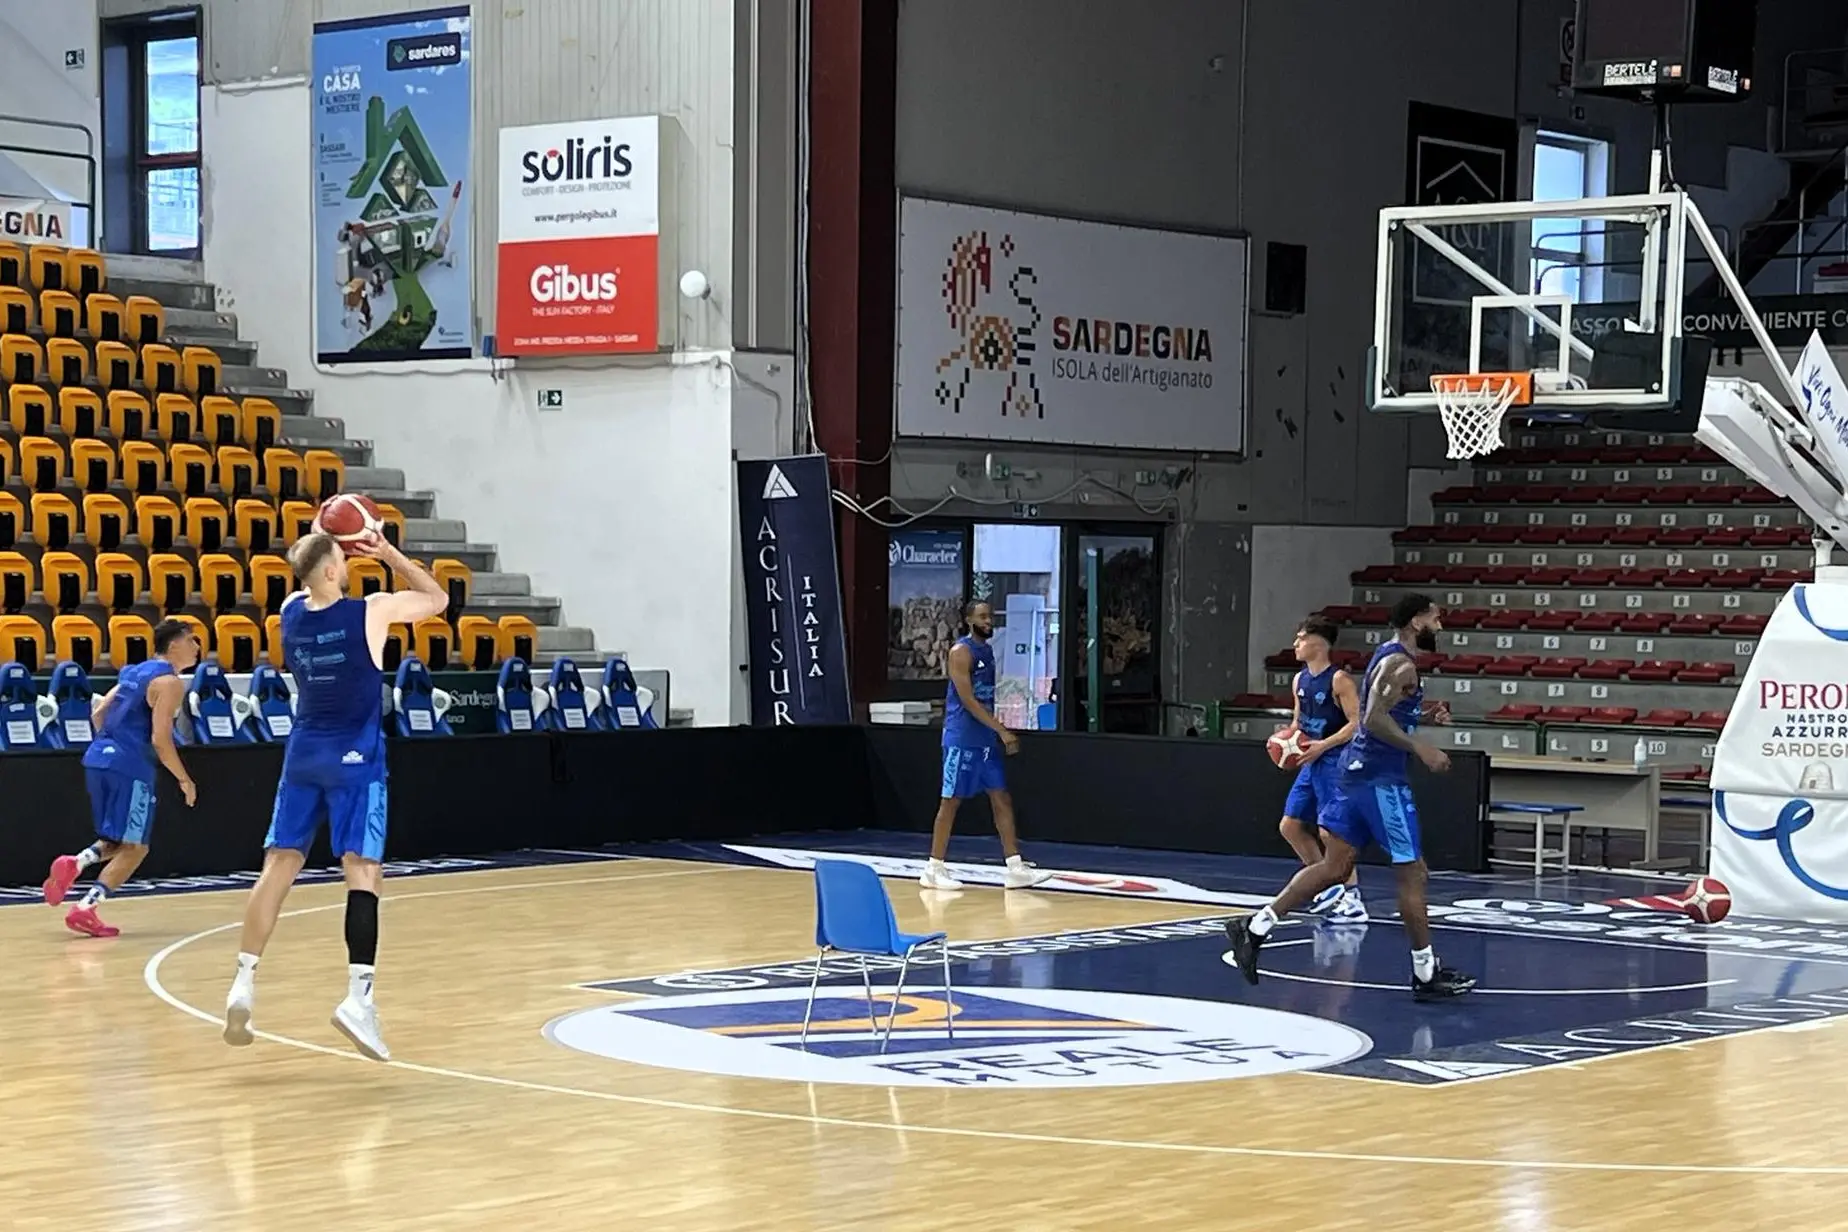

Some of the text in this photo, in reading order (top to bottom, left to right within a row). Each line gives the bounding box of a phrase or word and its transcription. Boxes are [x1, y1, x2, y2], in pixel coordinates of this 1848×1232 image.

[409, 44, 457, 61] sardares
[324, 72, 361, 92] CASA
[522, 135, 633, 184] soliris
[559, 183, 584, 193] DESIGN
[0, 211, 62, 239] GNA
[530, 263, 618, 303] Gibus
[532, 306, 544, 316] THE
[561, 305, 592, 315] FACTORY
[1053, 316, 1213, 362] SARDEGNA
[1052, 358, 1213, 392] ISOLA dell'Artigianato
[801, 576, 824, 677] ITALIA
[1737, 643, 1751, 653] 10
[1786, 713, 1848, 724] NASTRO
[1651, 742, 1663, 753] 10
[1762, 742, 1848, 758] SARDEG
[874, 1037, 1278, 1076] REALE
[932, 1049, 1330, 1086] MUTUA
